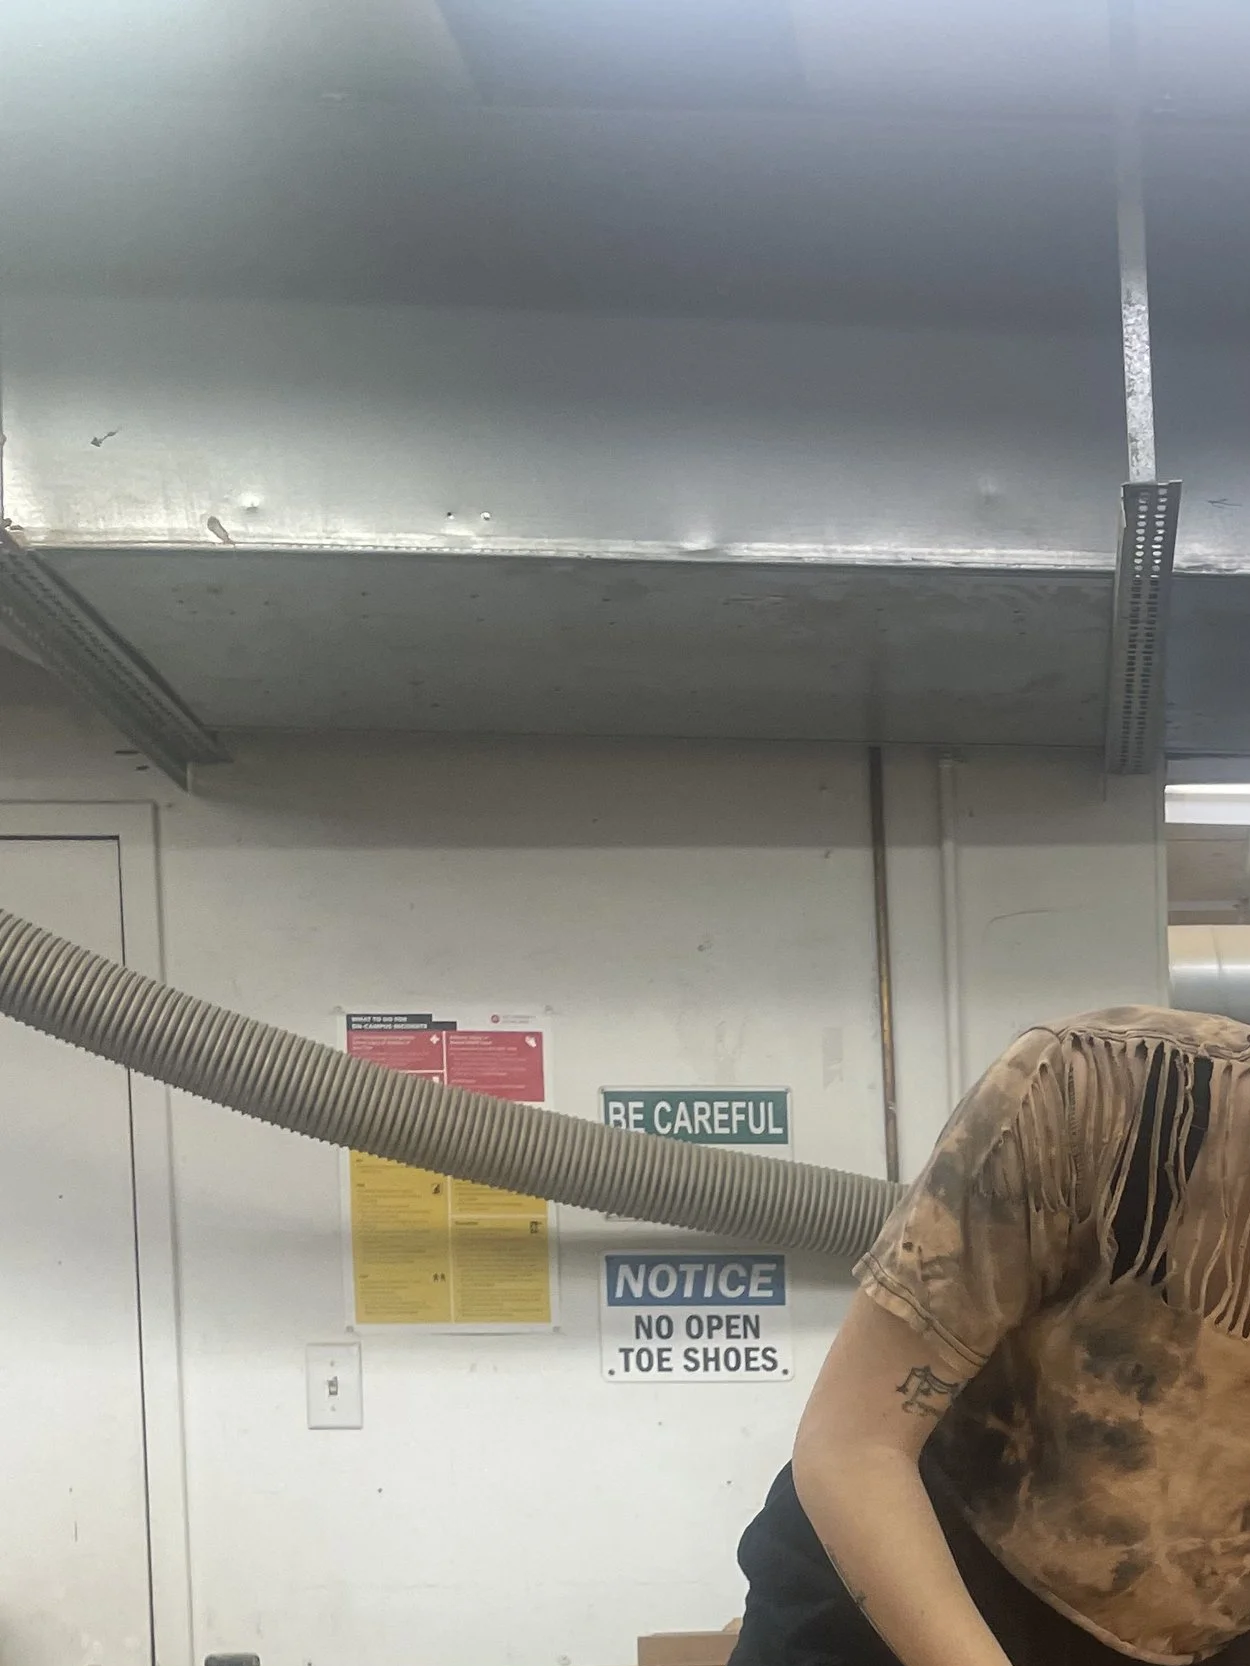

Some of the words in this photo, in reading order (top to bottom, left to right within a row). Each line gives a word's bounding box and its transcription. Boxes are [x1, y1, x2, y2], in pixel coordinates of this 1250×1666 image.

[608, 1101, 646, 1133] BE
[653, 1101, 784, 1135] CAREFUL
[615, 1263, 777, 1299] NOTICE
[634, 1315, 674, 1340] NO
[685, 1315, 761, 1340] OPEN
[618, 1347, 673, 1373] TOE
[683, 1346, 778, 1372] SHOES
